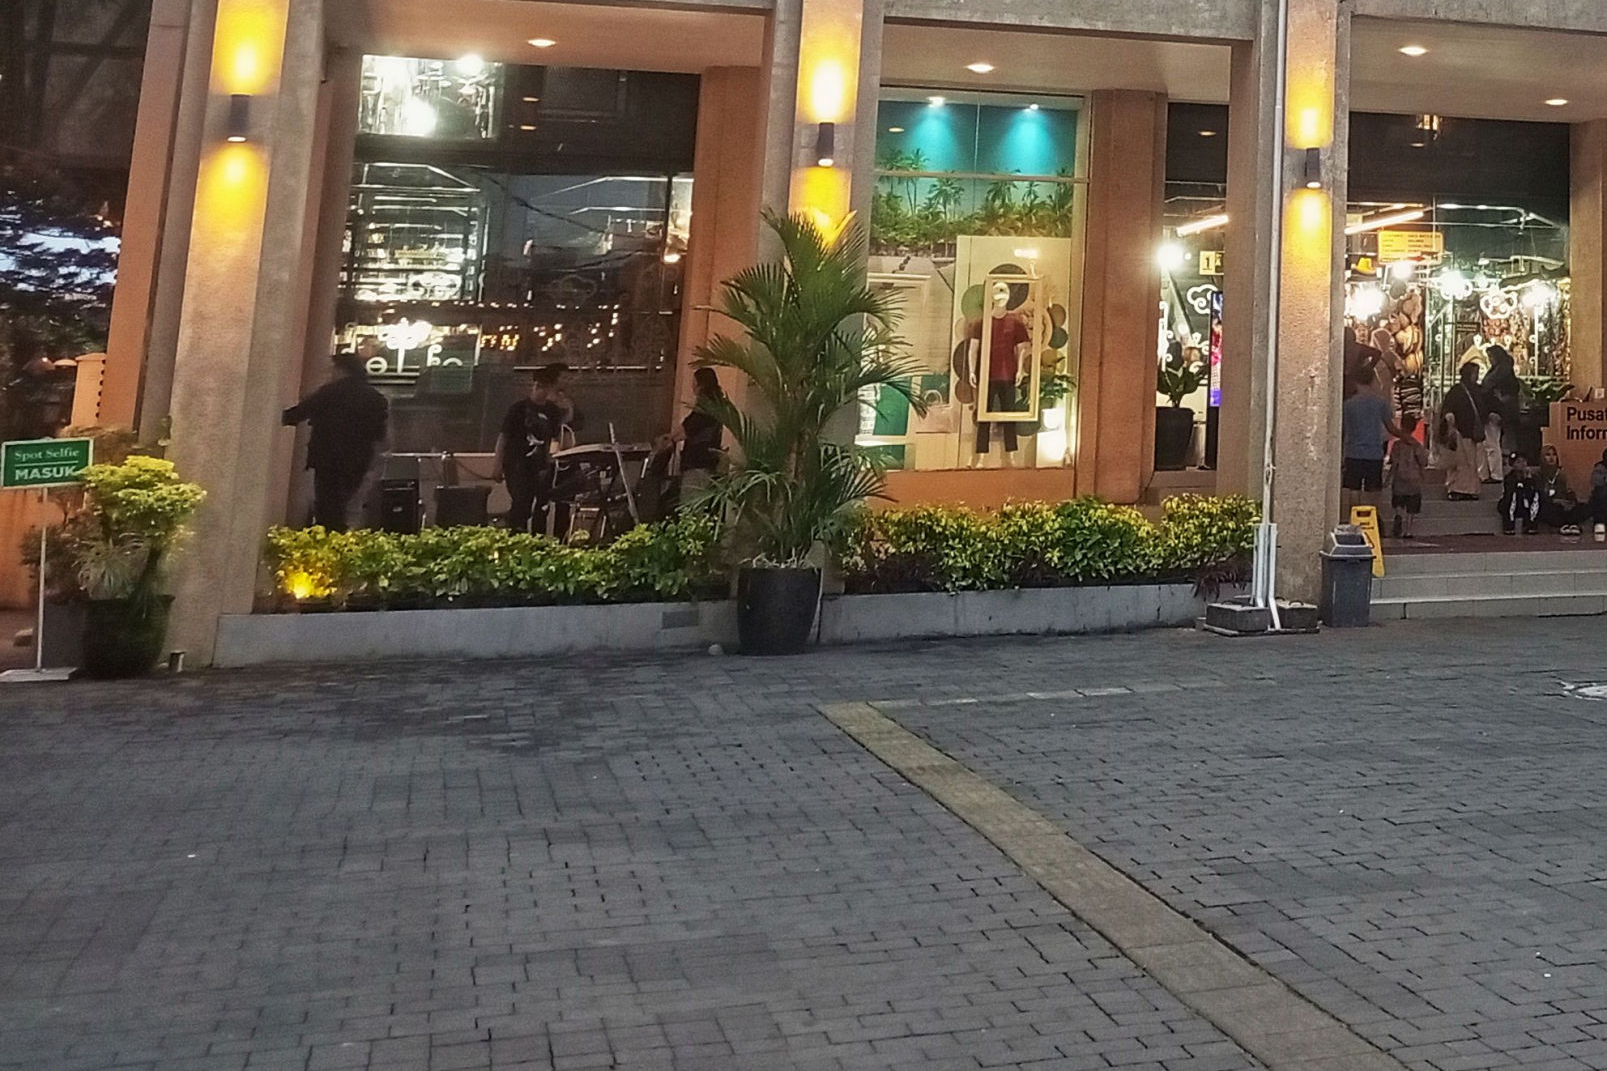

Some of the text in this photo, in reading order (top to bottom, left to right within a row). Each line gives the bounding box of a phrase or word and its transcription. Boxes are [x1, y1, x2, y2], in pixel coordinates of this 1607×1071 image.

[14, 446, 80, 462] Spot Selfie
[14, 465, 79, 481] MASUK
